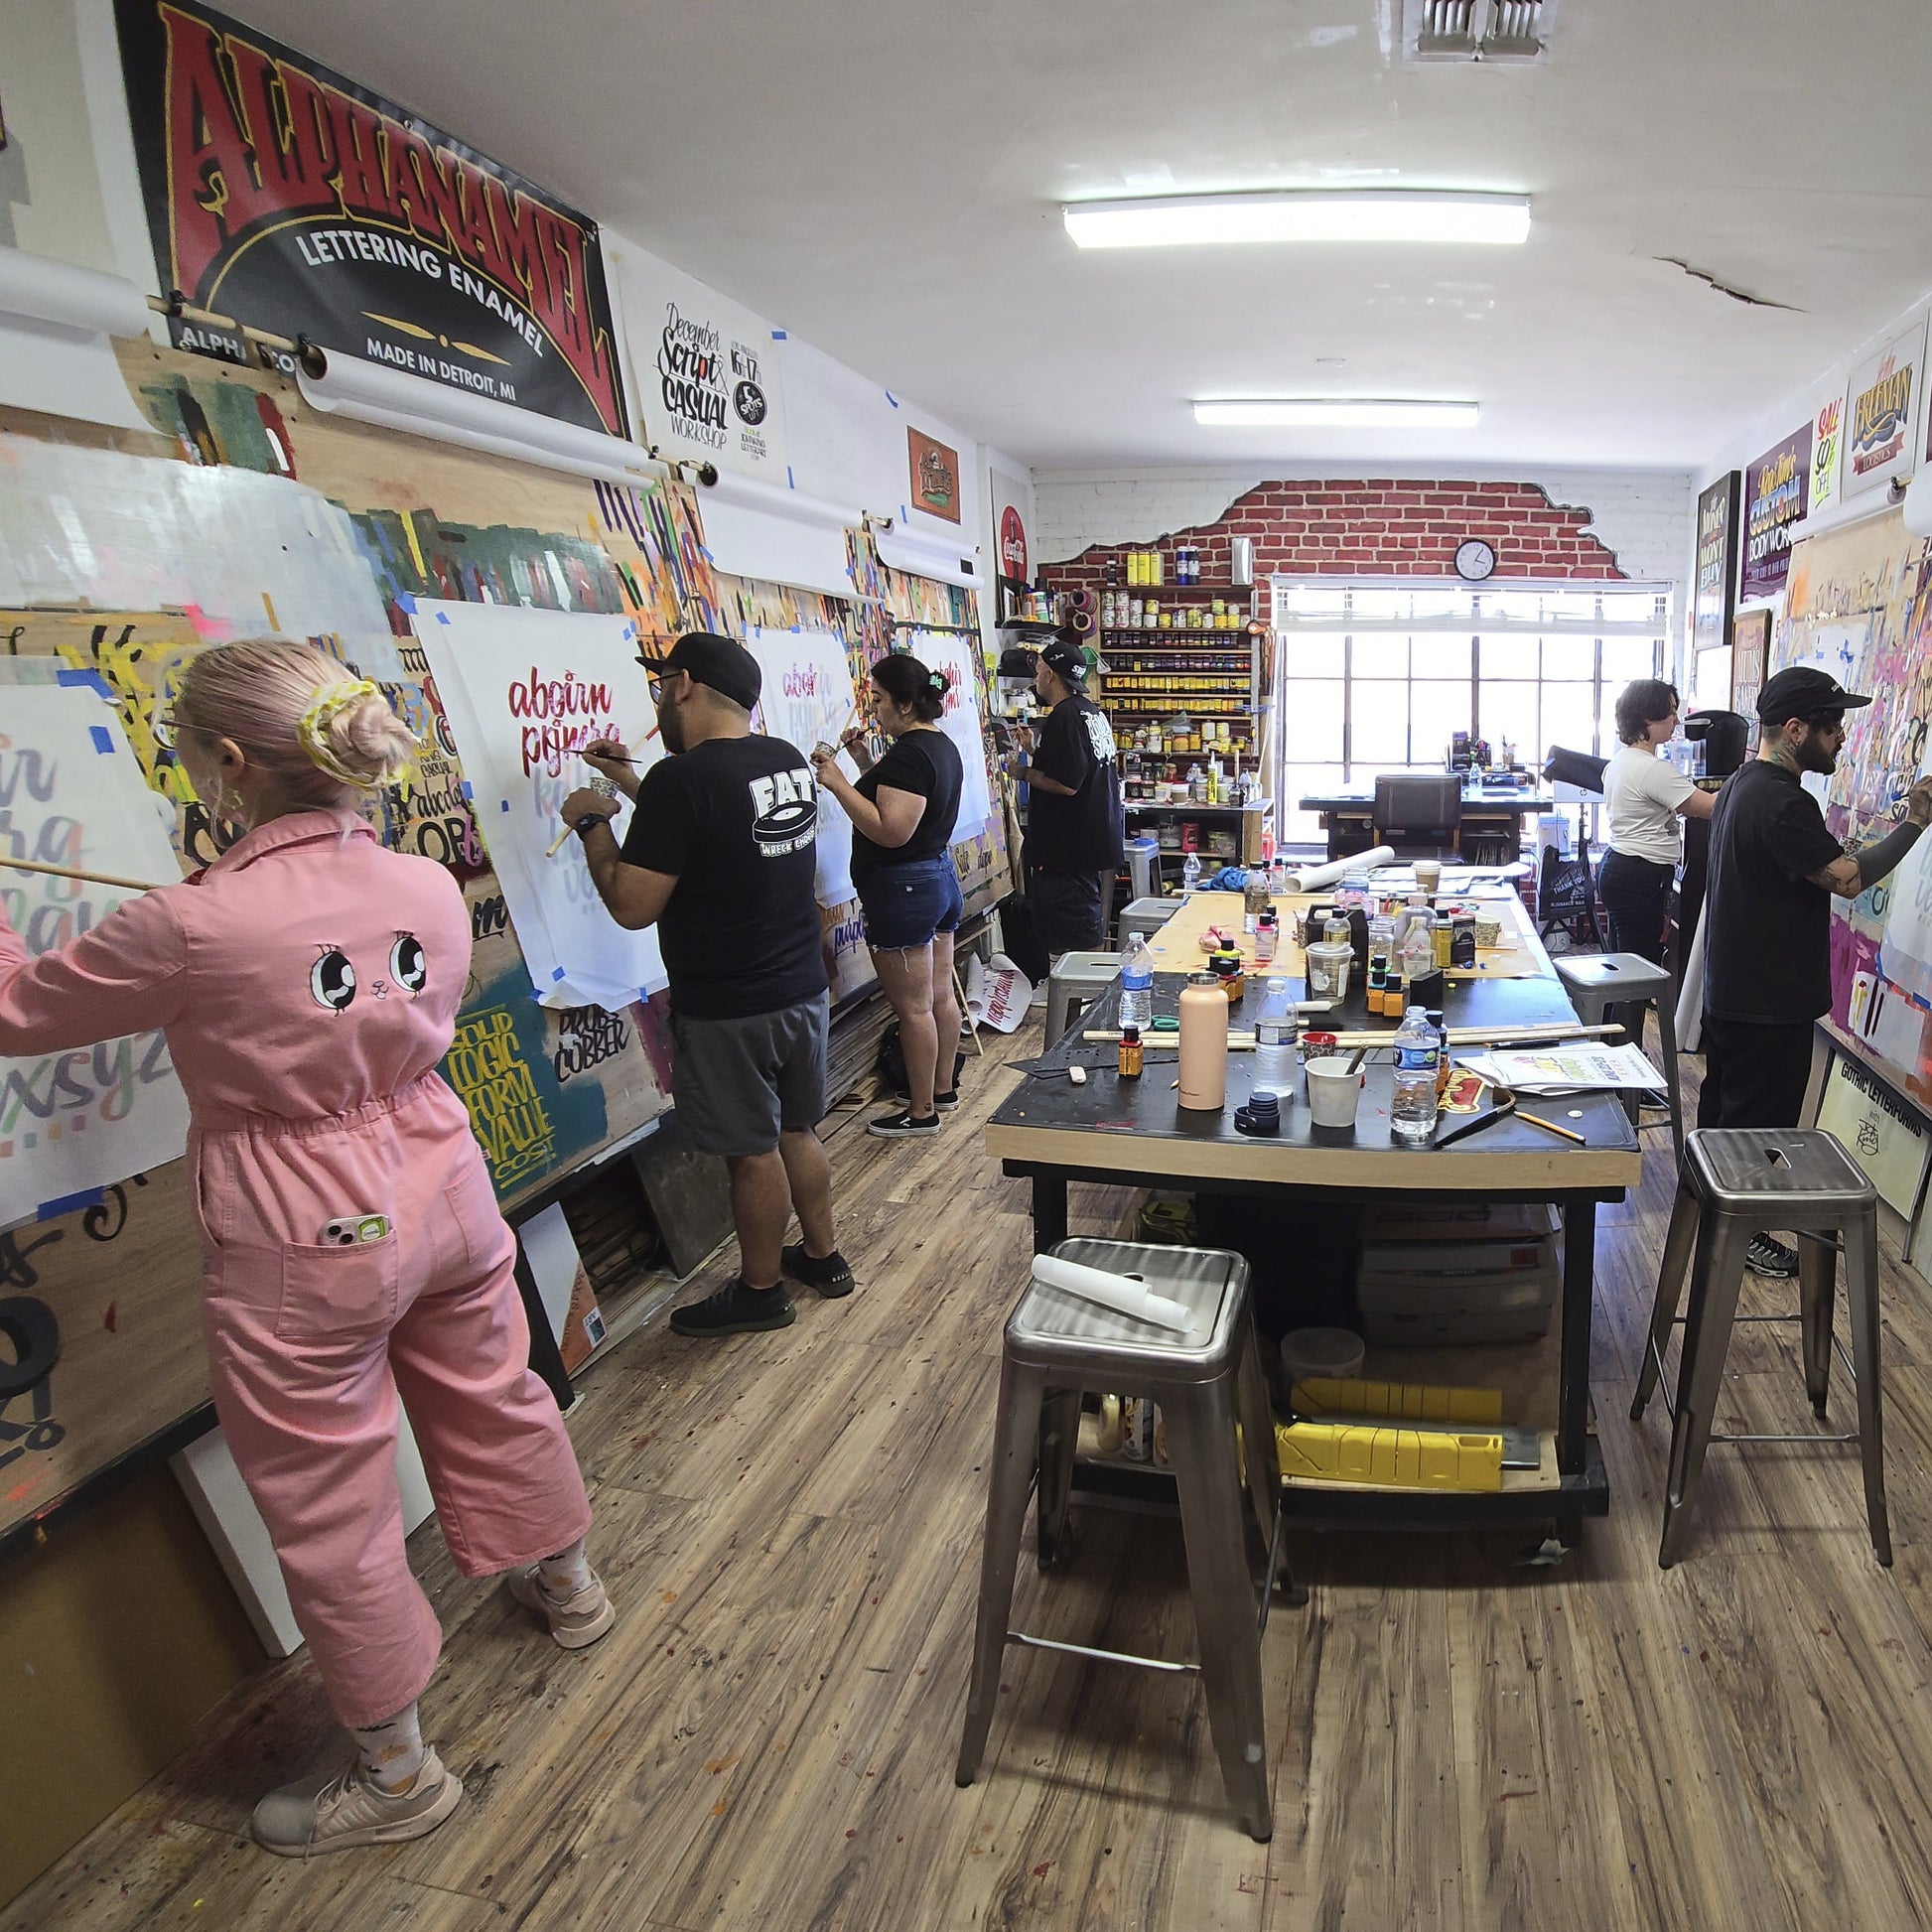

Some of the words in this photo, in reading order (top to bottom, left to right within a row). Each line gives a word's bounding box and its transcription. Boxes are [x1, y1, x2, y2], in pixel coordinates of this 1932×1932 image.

[159, 2, 621, 438] ALPHANAMEL
[295, 228, 443, 279] LETTERING
[448, 262, 544, 358] ENAMEL
[666, 302, 720, 351] December
[366, 338, 417, 370] MADE
[418, 353, 437, 376] IN
[439, 359, 497, 397] DETROIT,
[499, 382, 517, 402] MI
[652, 327, 717, 389] Script
[661, 377, 730, 430] CASUAL
[670, 414, 728, 451] WORKSHOP
[1862, 445, 1892, 472] LOGISTICS
[1749, 475, 1802, 537] CUSTOM
[1749, 531, 1767, 563] BODY
[750, 767, 813, 819] FAT
[759, 842, 793, 857] WRECK
[450, 1012, 514, 1050] SOLID
[447, 1033, 525, 1094] LOGIC
[464, 1062, 537, 1130] FORM
[1841, 1061, 1869, 1095] GOTHIC
[1867, 1081, 1923, 1138] LETTERFORMS
[493, 1134, 557, 1179] COST
